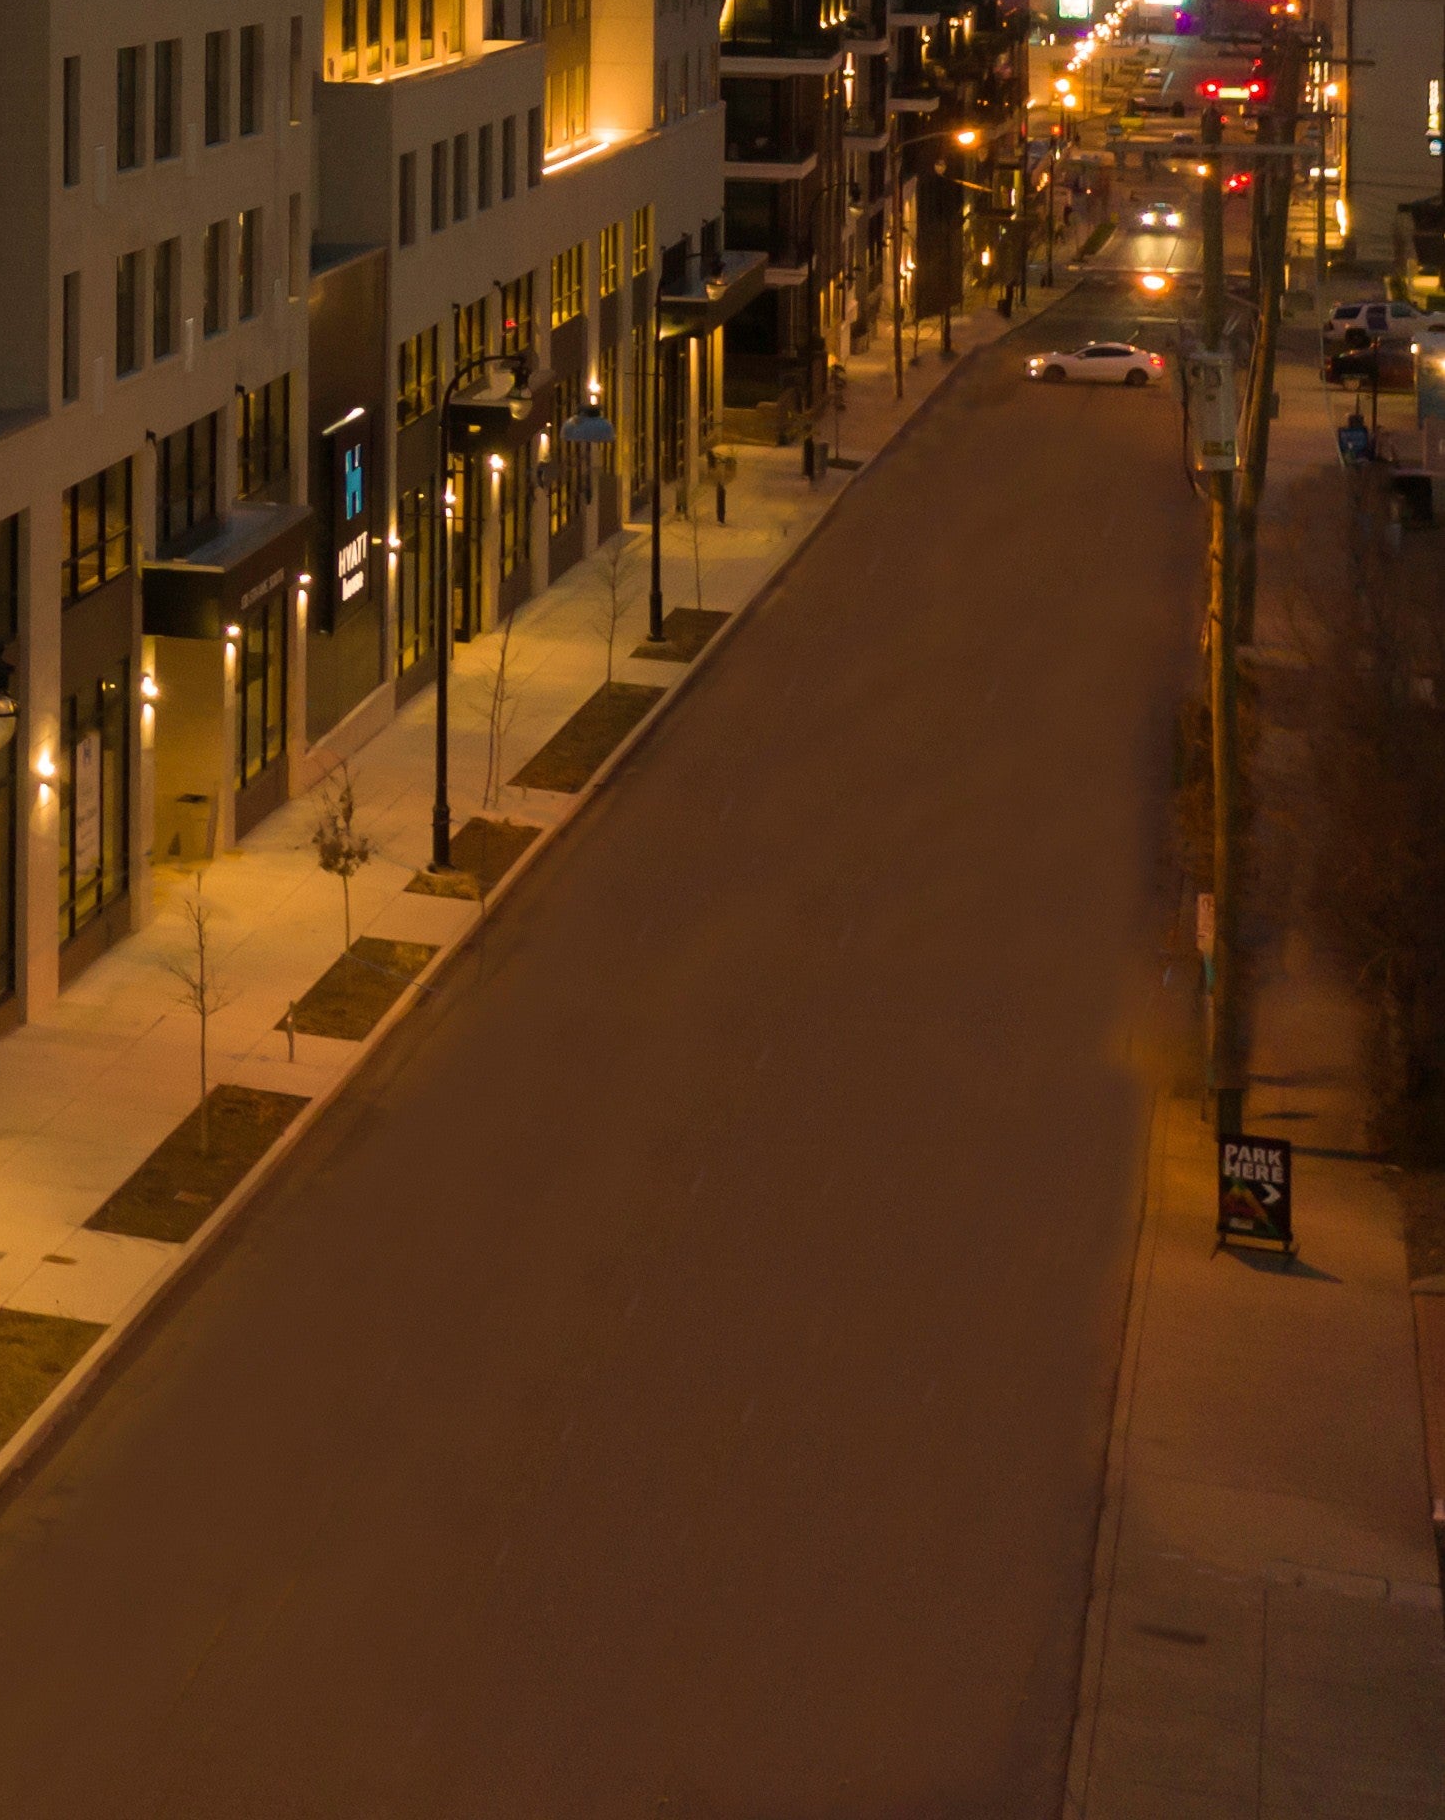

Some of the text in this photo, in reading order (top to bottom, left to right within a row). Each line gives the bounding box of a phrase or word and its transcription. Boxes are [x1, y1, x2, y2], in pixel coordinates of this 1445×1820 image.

[338, 530, 368, 578] HYATT
[1224, 1143, 1283, 1166] PARK
[1223, 1159, 1284, 1184] HERE
